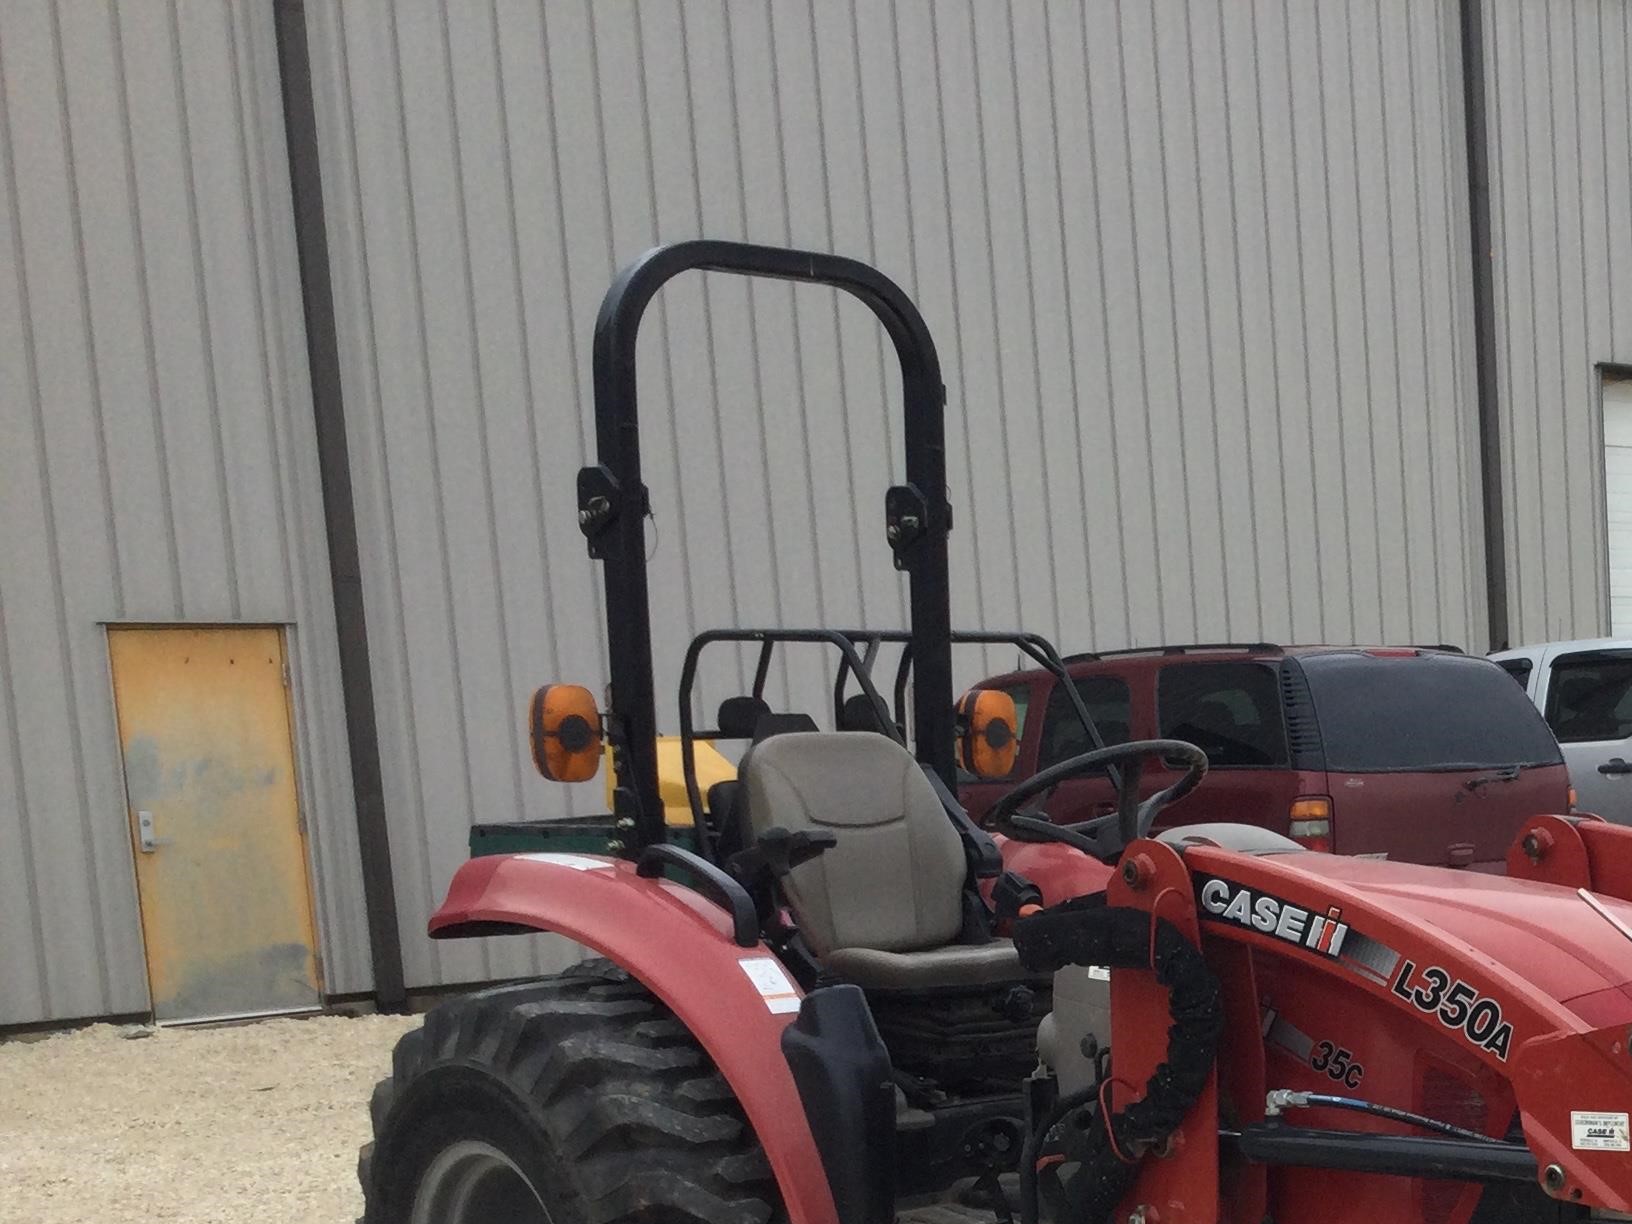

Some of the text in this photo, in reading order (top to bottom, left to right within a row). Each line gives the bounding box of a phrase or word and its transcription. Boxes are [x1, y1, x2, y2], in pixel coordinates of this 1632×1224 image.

[1201, 879, 1309, 943] CASE
[1391, 959, 1514, 1063] L350A
[1310, 1039, 1364, 1090] 35C
